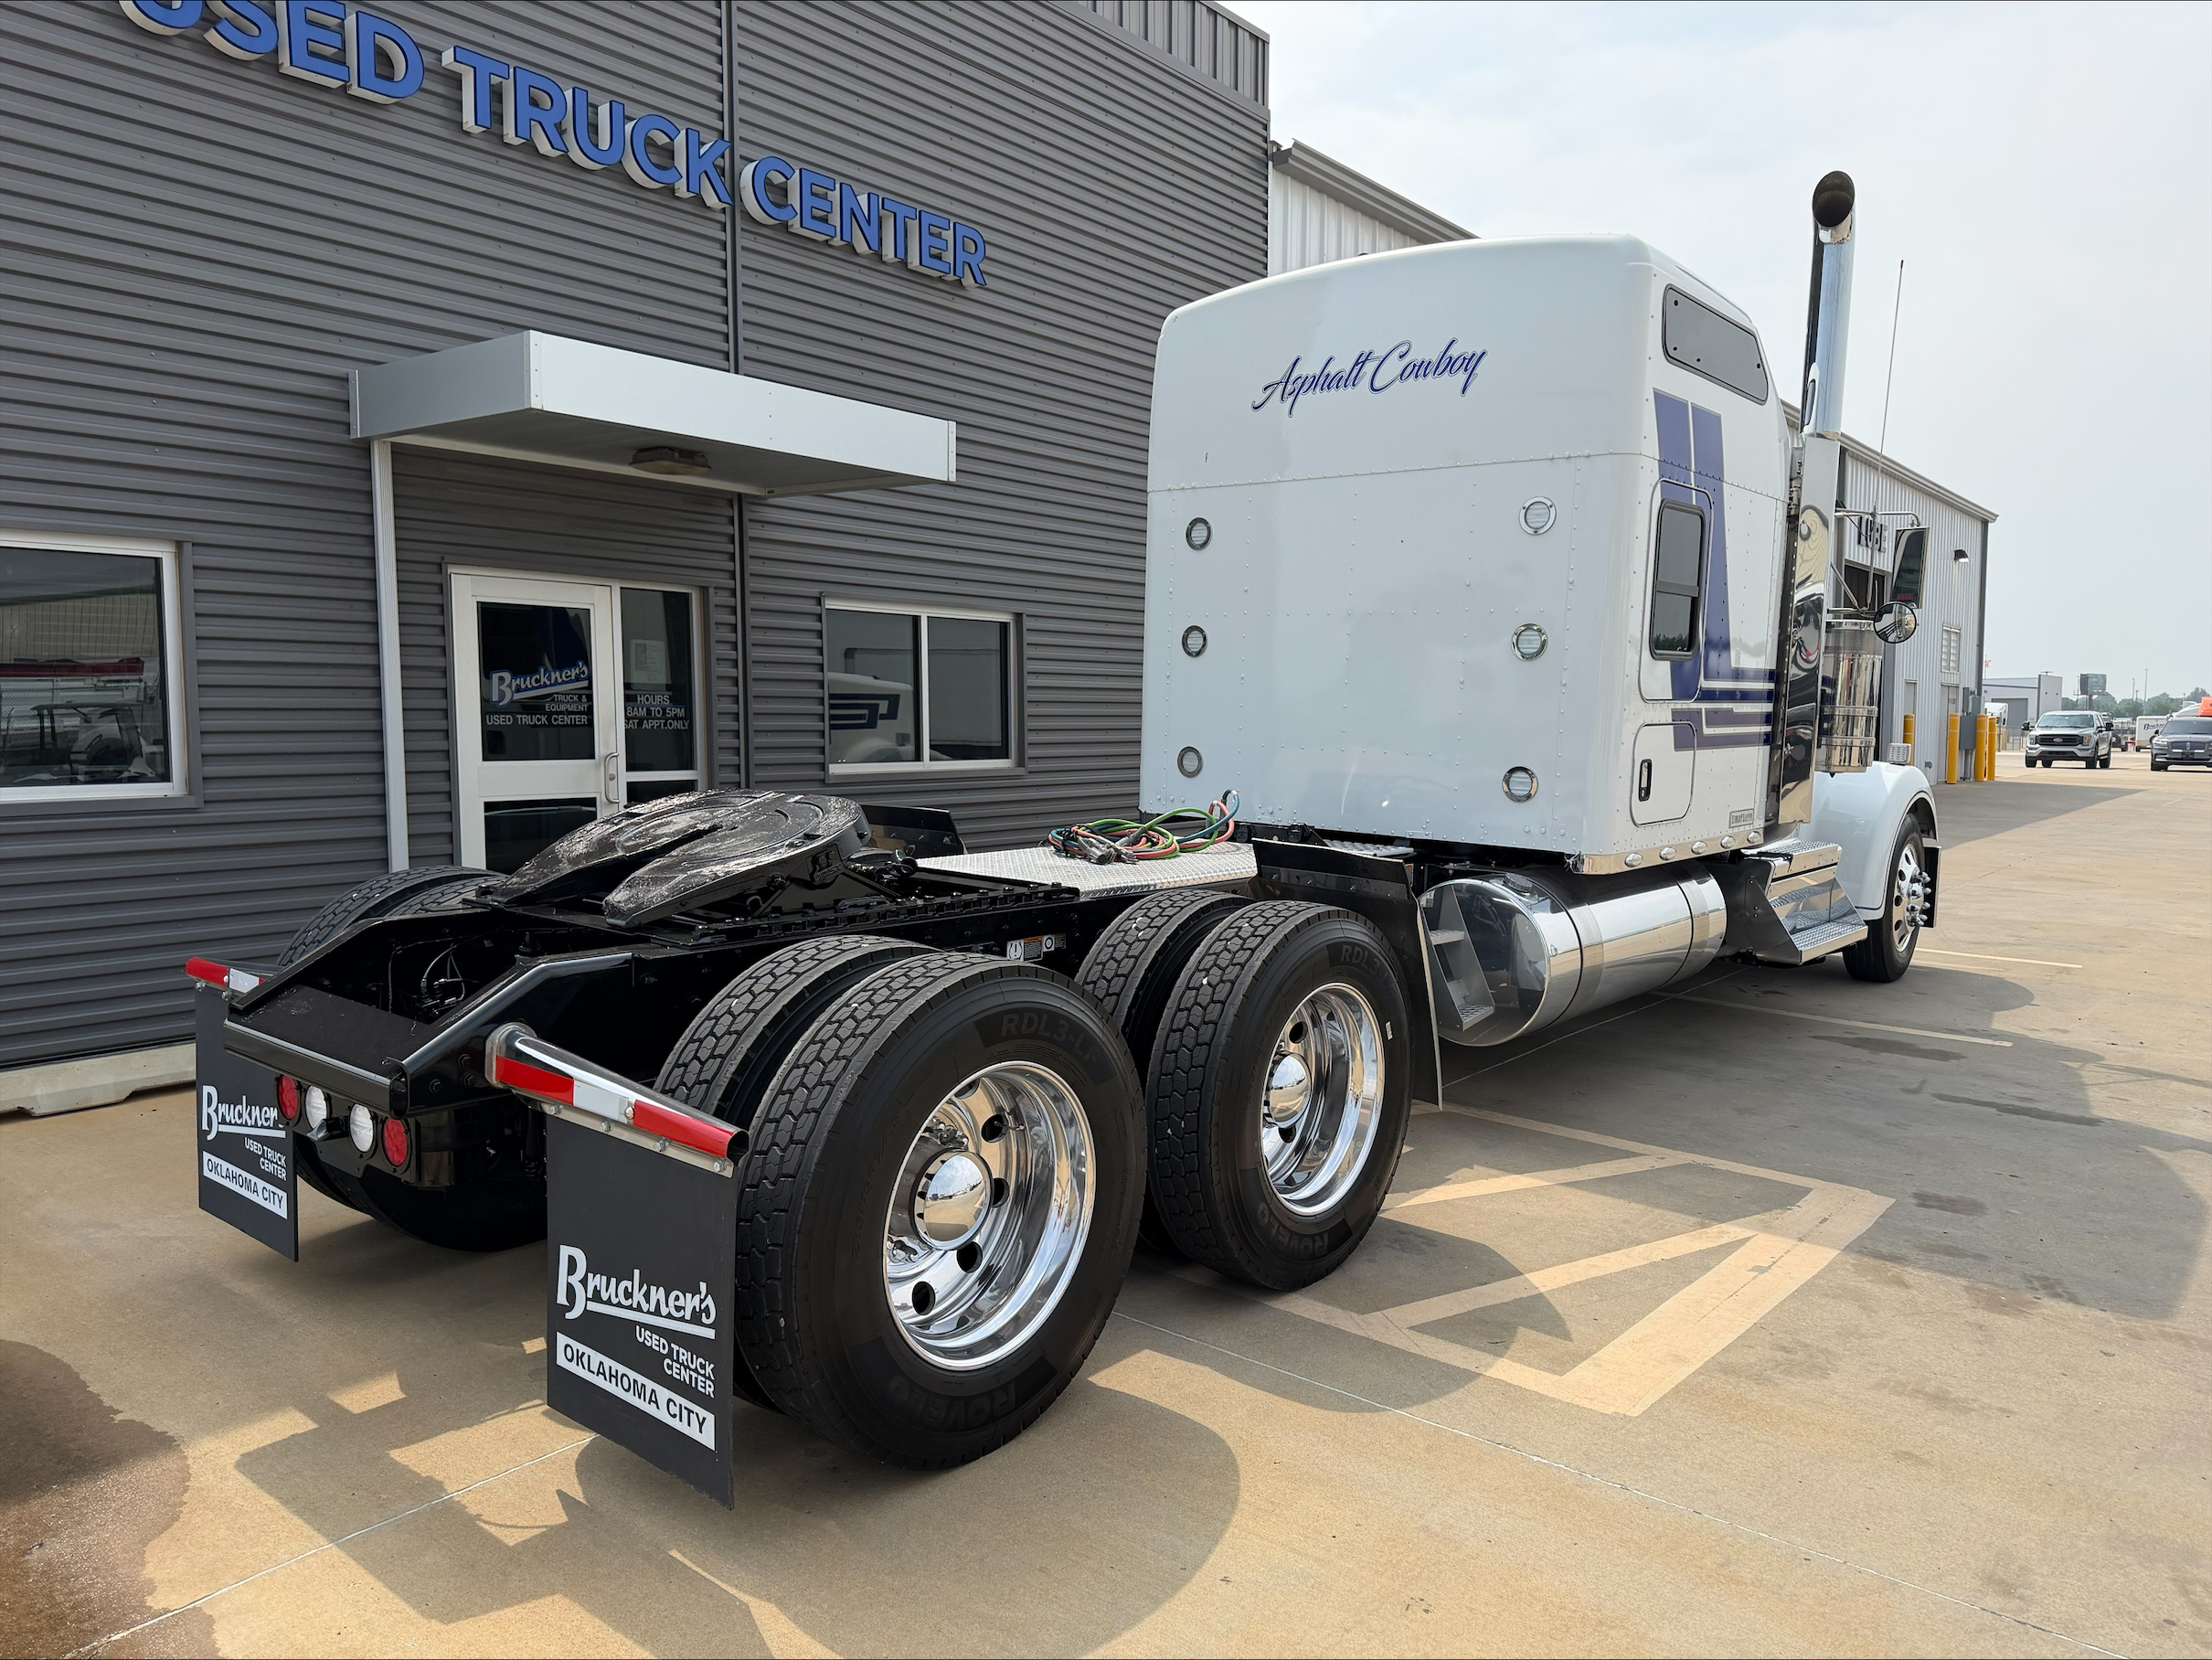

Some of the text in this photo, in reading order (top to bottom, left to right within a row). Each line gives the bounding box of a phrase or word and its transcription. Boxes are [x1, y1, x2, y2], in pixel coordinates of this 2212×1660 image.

[442, 45, 735, 210] TRUCK
[739, 155, 987, 289] CENTER
[1250, 336, 1489, 418] Asphalt Cowboy
[491, 661, 590, 707] Bruckner's
[545, 703, 589, 712] EQUIPMENT
[553, 694, 588, 703] TRUCK &
[636, 694, 671, 705] HOURS
[485, 714, 588, 725] USED TRUCK CENTER
[626, 706, 686, 718] 8AM TO 5PM
[202, 1085, 284, 1141] Bruckner
[244, 1136, 287, 1168] USED TRUCK
[259, 1157, 287, 1181] CENTER
[207, 1158, 283, 1209] OKLAHOMA CITY
[1256, 1201, 1329, 1260] ROVELO
[556, 1244, 717, 1325] Bruckner's
[635, 1325, 716, 1380] USED TRUCK
[563, 1343, 708, 1435] OKLAHOMA CITY
[663, 1358, 716, 1399] CENTER
[888, 1374, 1017, 1430] ROVELO
